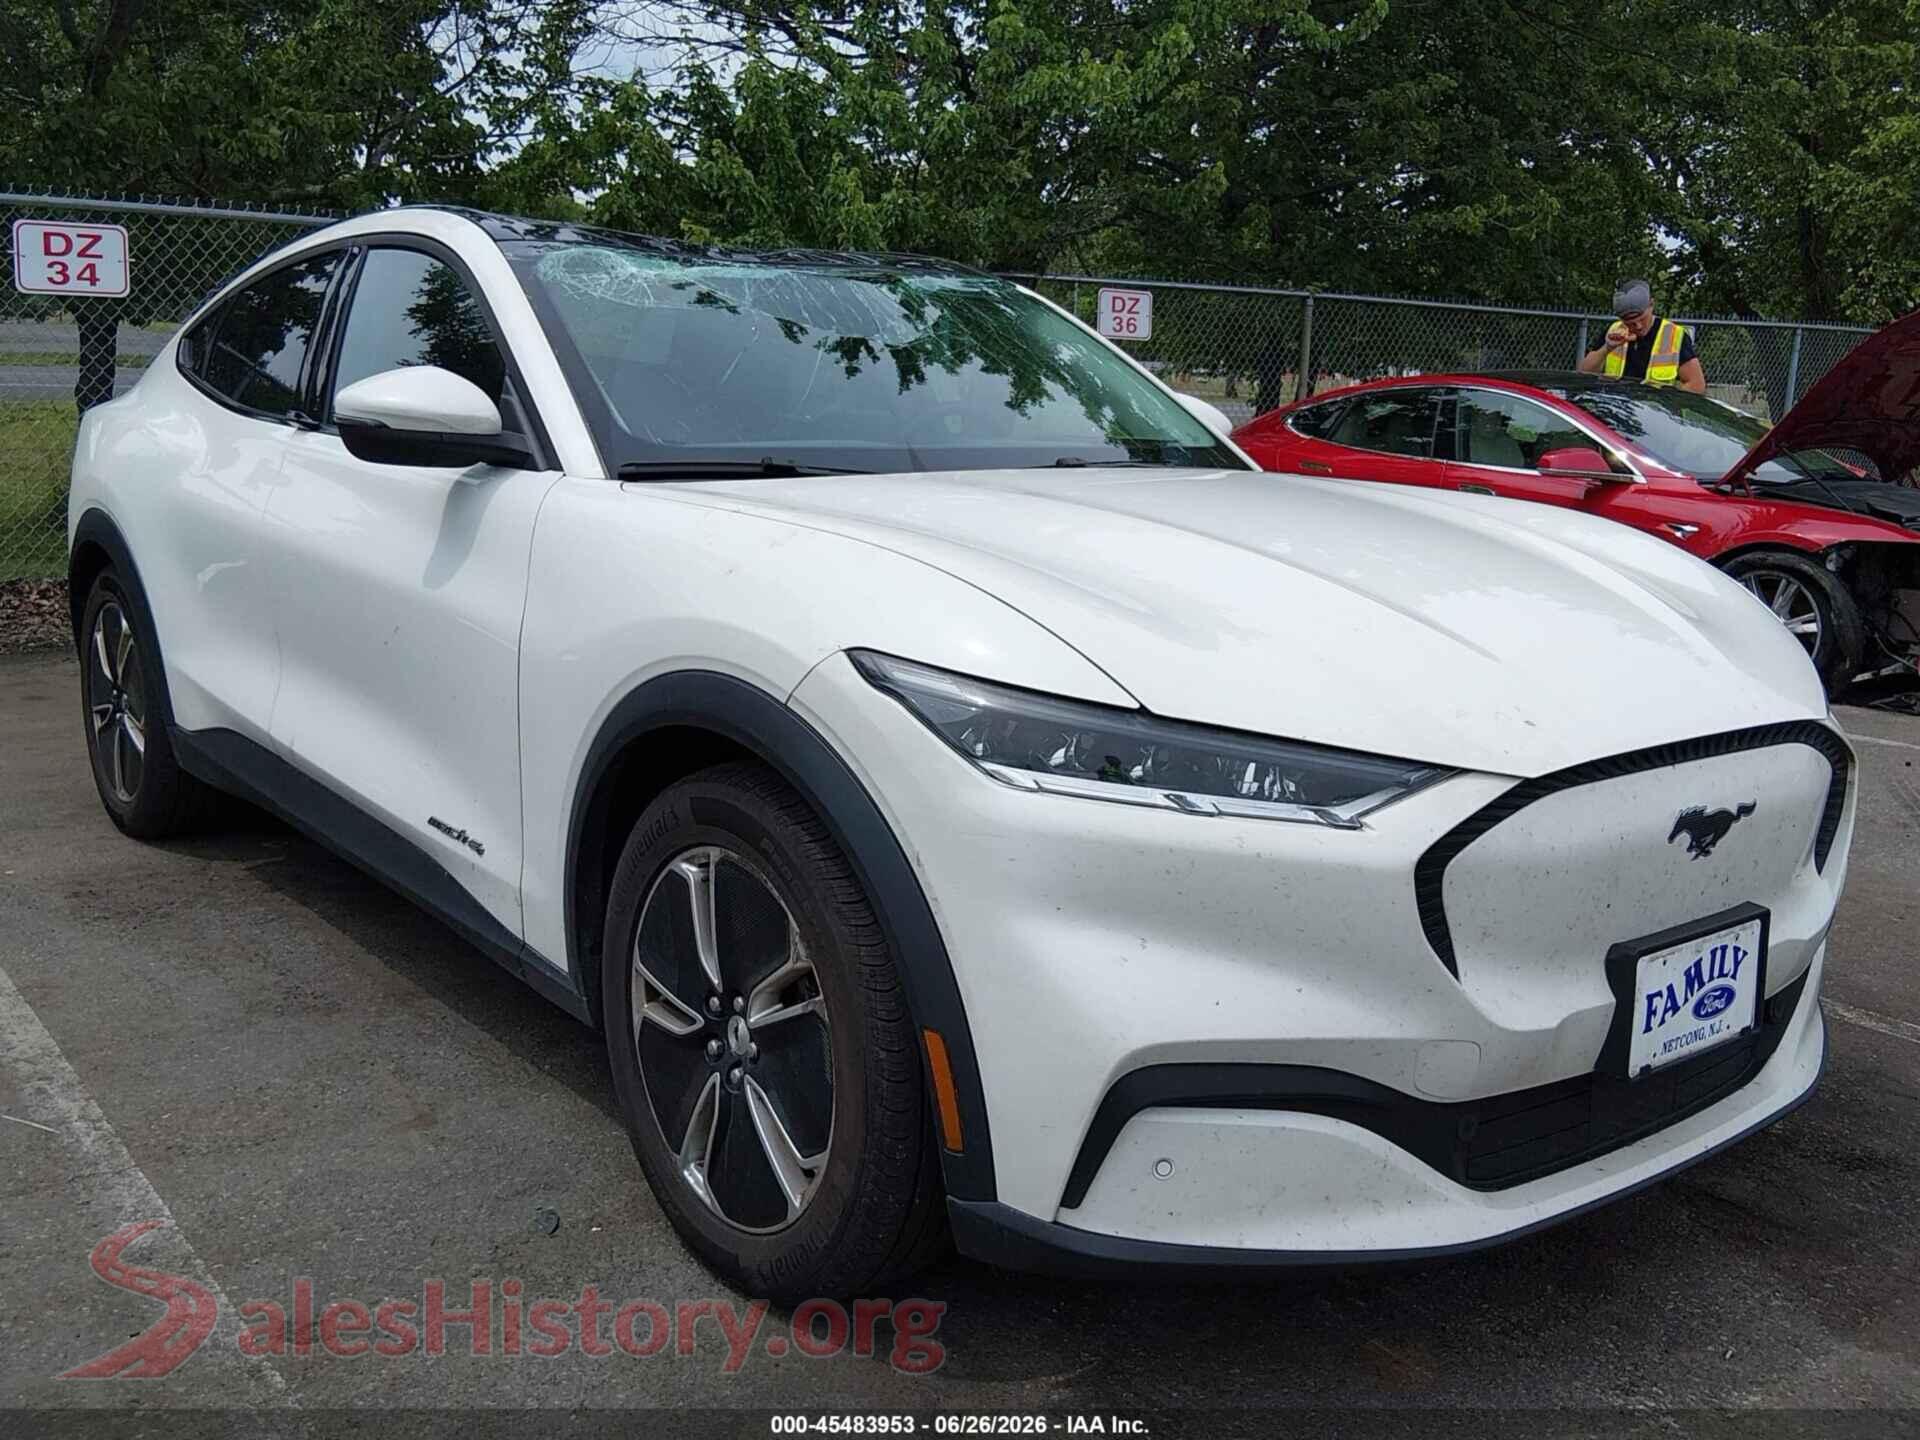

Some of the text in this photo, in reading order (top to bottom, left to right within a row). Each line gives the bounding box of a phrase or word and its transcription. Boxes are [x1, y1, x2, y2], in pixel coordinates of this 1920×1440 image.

[43, 231, 103, 259] DZ
[47, 261, 101, 287] 34
[1111, 296, 1140, 315] DZ
[1112, 316, 1137, 334] 36
[1642, 944, 1749, 1034] FAMILY
[1700, 990, 1730, 1015] Ford
[1660, 1026, 1706, 1056] NETCONG,
